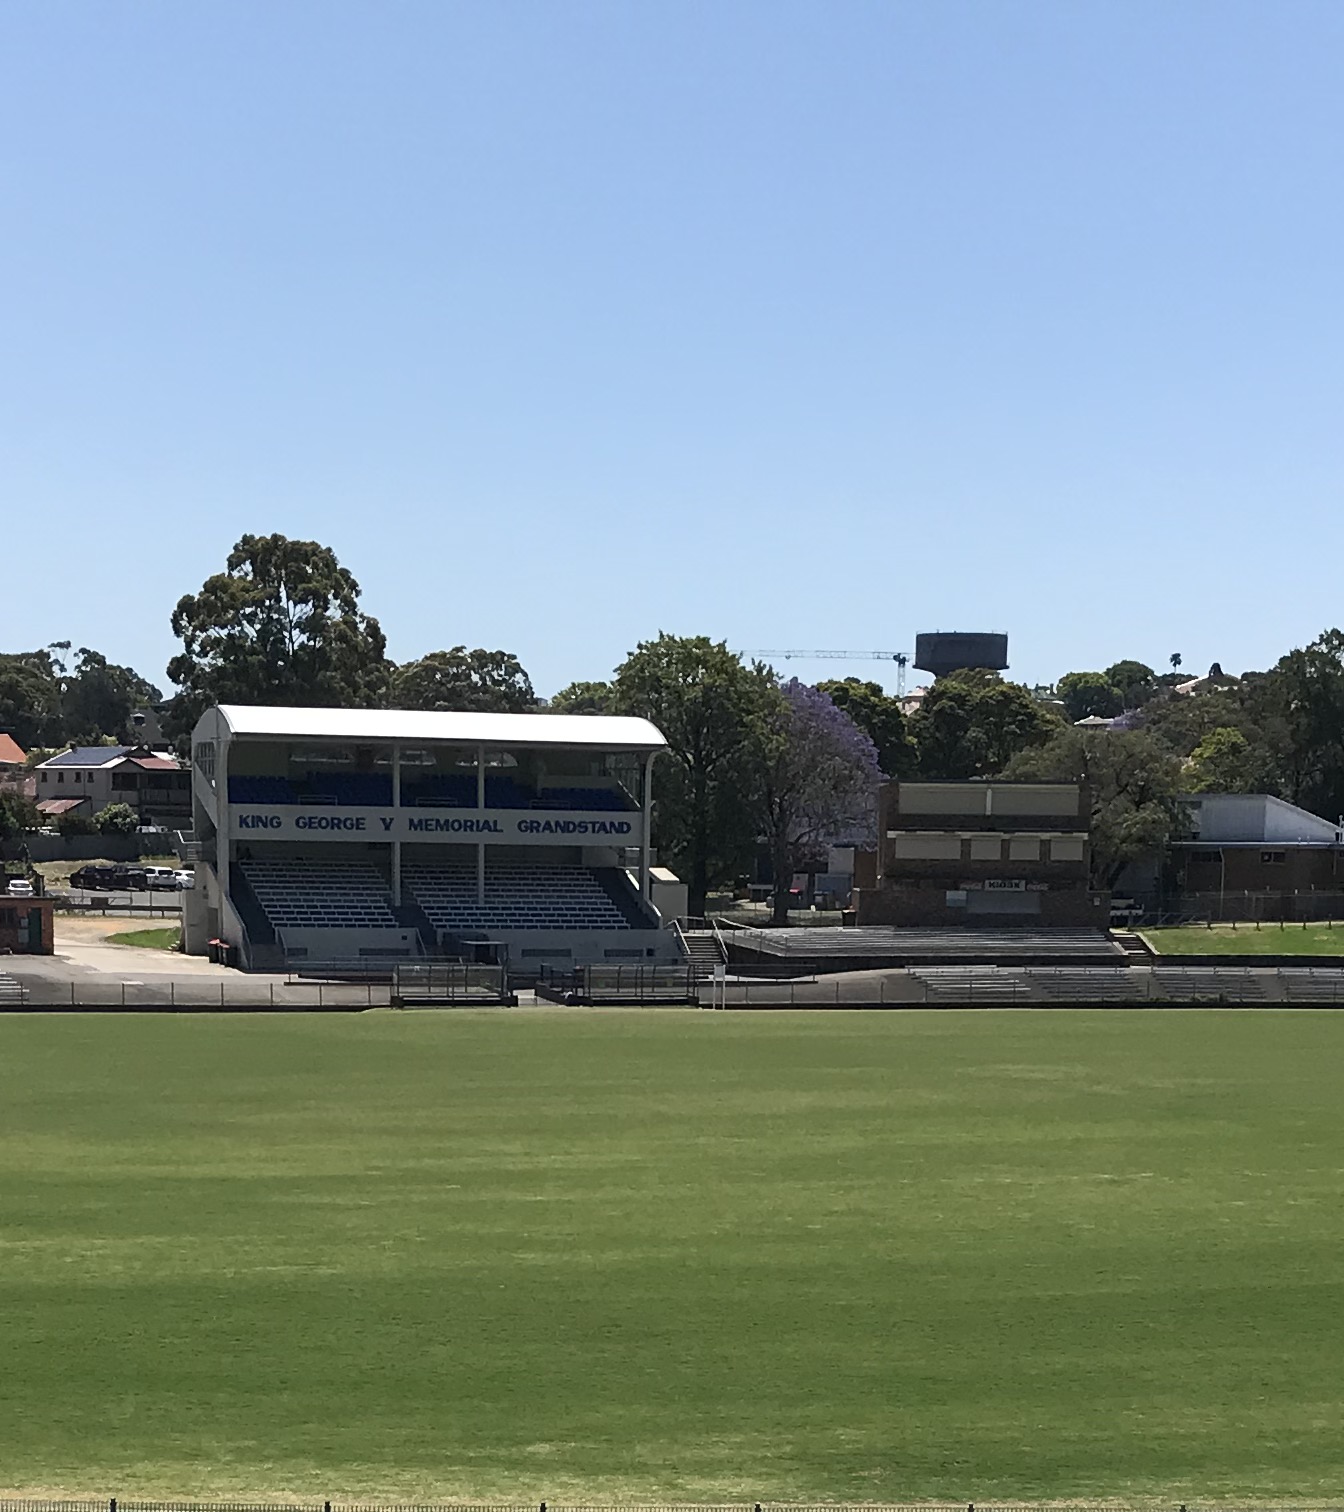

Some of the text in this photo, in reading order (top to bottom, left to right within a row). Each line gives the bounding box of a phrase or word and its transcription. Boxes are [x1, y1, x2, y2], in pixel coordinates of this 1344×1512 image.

[239, 814, 632, 834] KING GEORGE V MEMORIAL GRANDSTAND
[988, 880, 1021, 889] KIOSK
